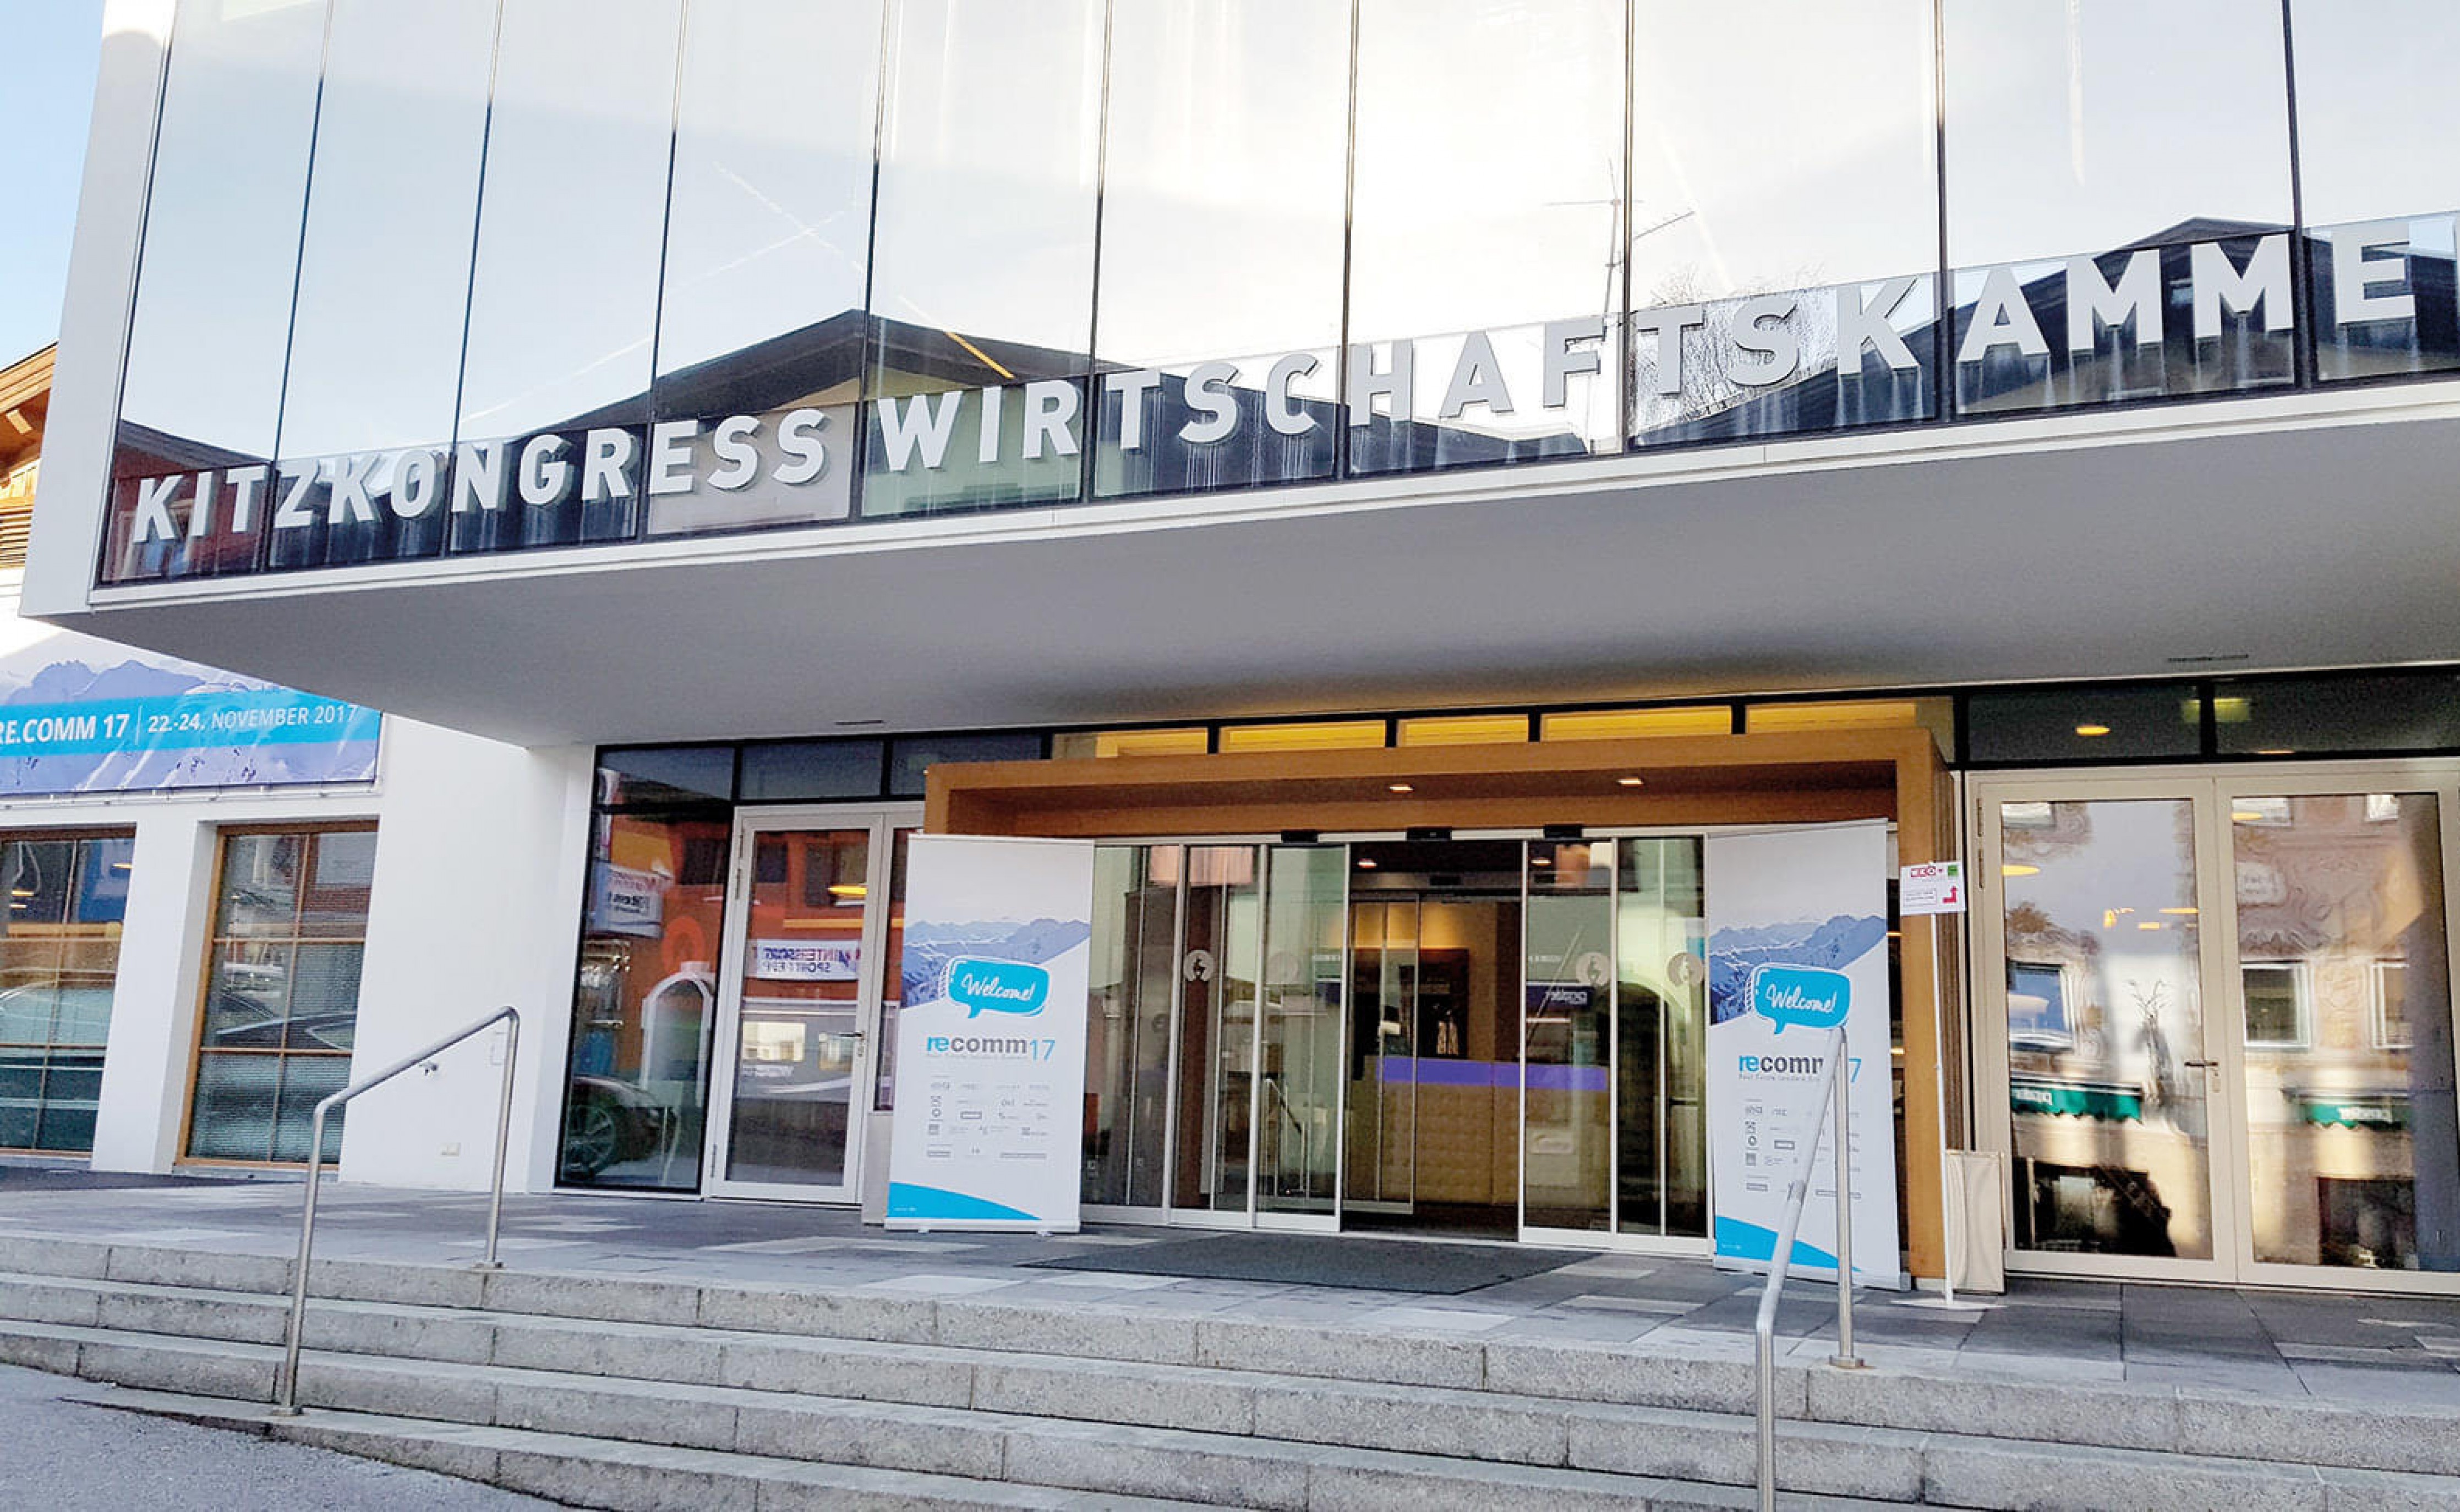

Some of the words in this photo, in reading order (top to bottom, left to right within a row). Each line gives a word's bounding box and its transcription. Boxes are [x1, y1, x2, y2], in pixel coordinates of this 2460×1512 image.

[133, 408, 827, 544] KITZKONGRESS
[877, 213, 2460, 472] WIRTSCHAFTSKAMME
[103, 714, 130, 738] 17
[211, 708, 309, 730] NOVEMBER
[314, 705, 359, 724] 2017
[960, 973, 1036, 1002] Welcome!
[1765, 984, 1838, 1013] Welcome!
